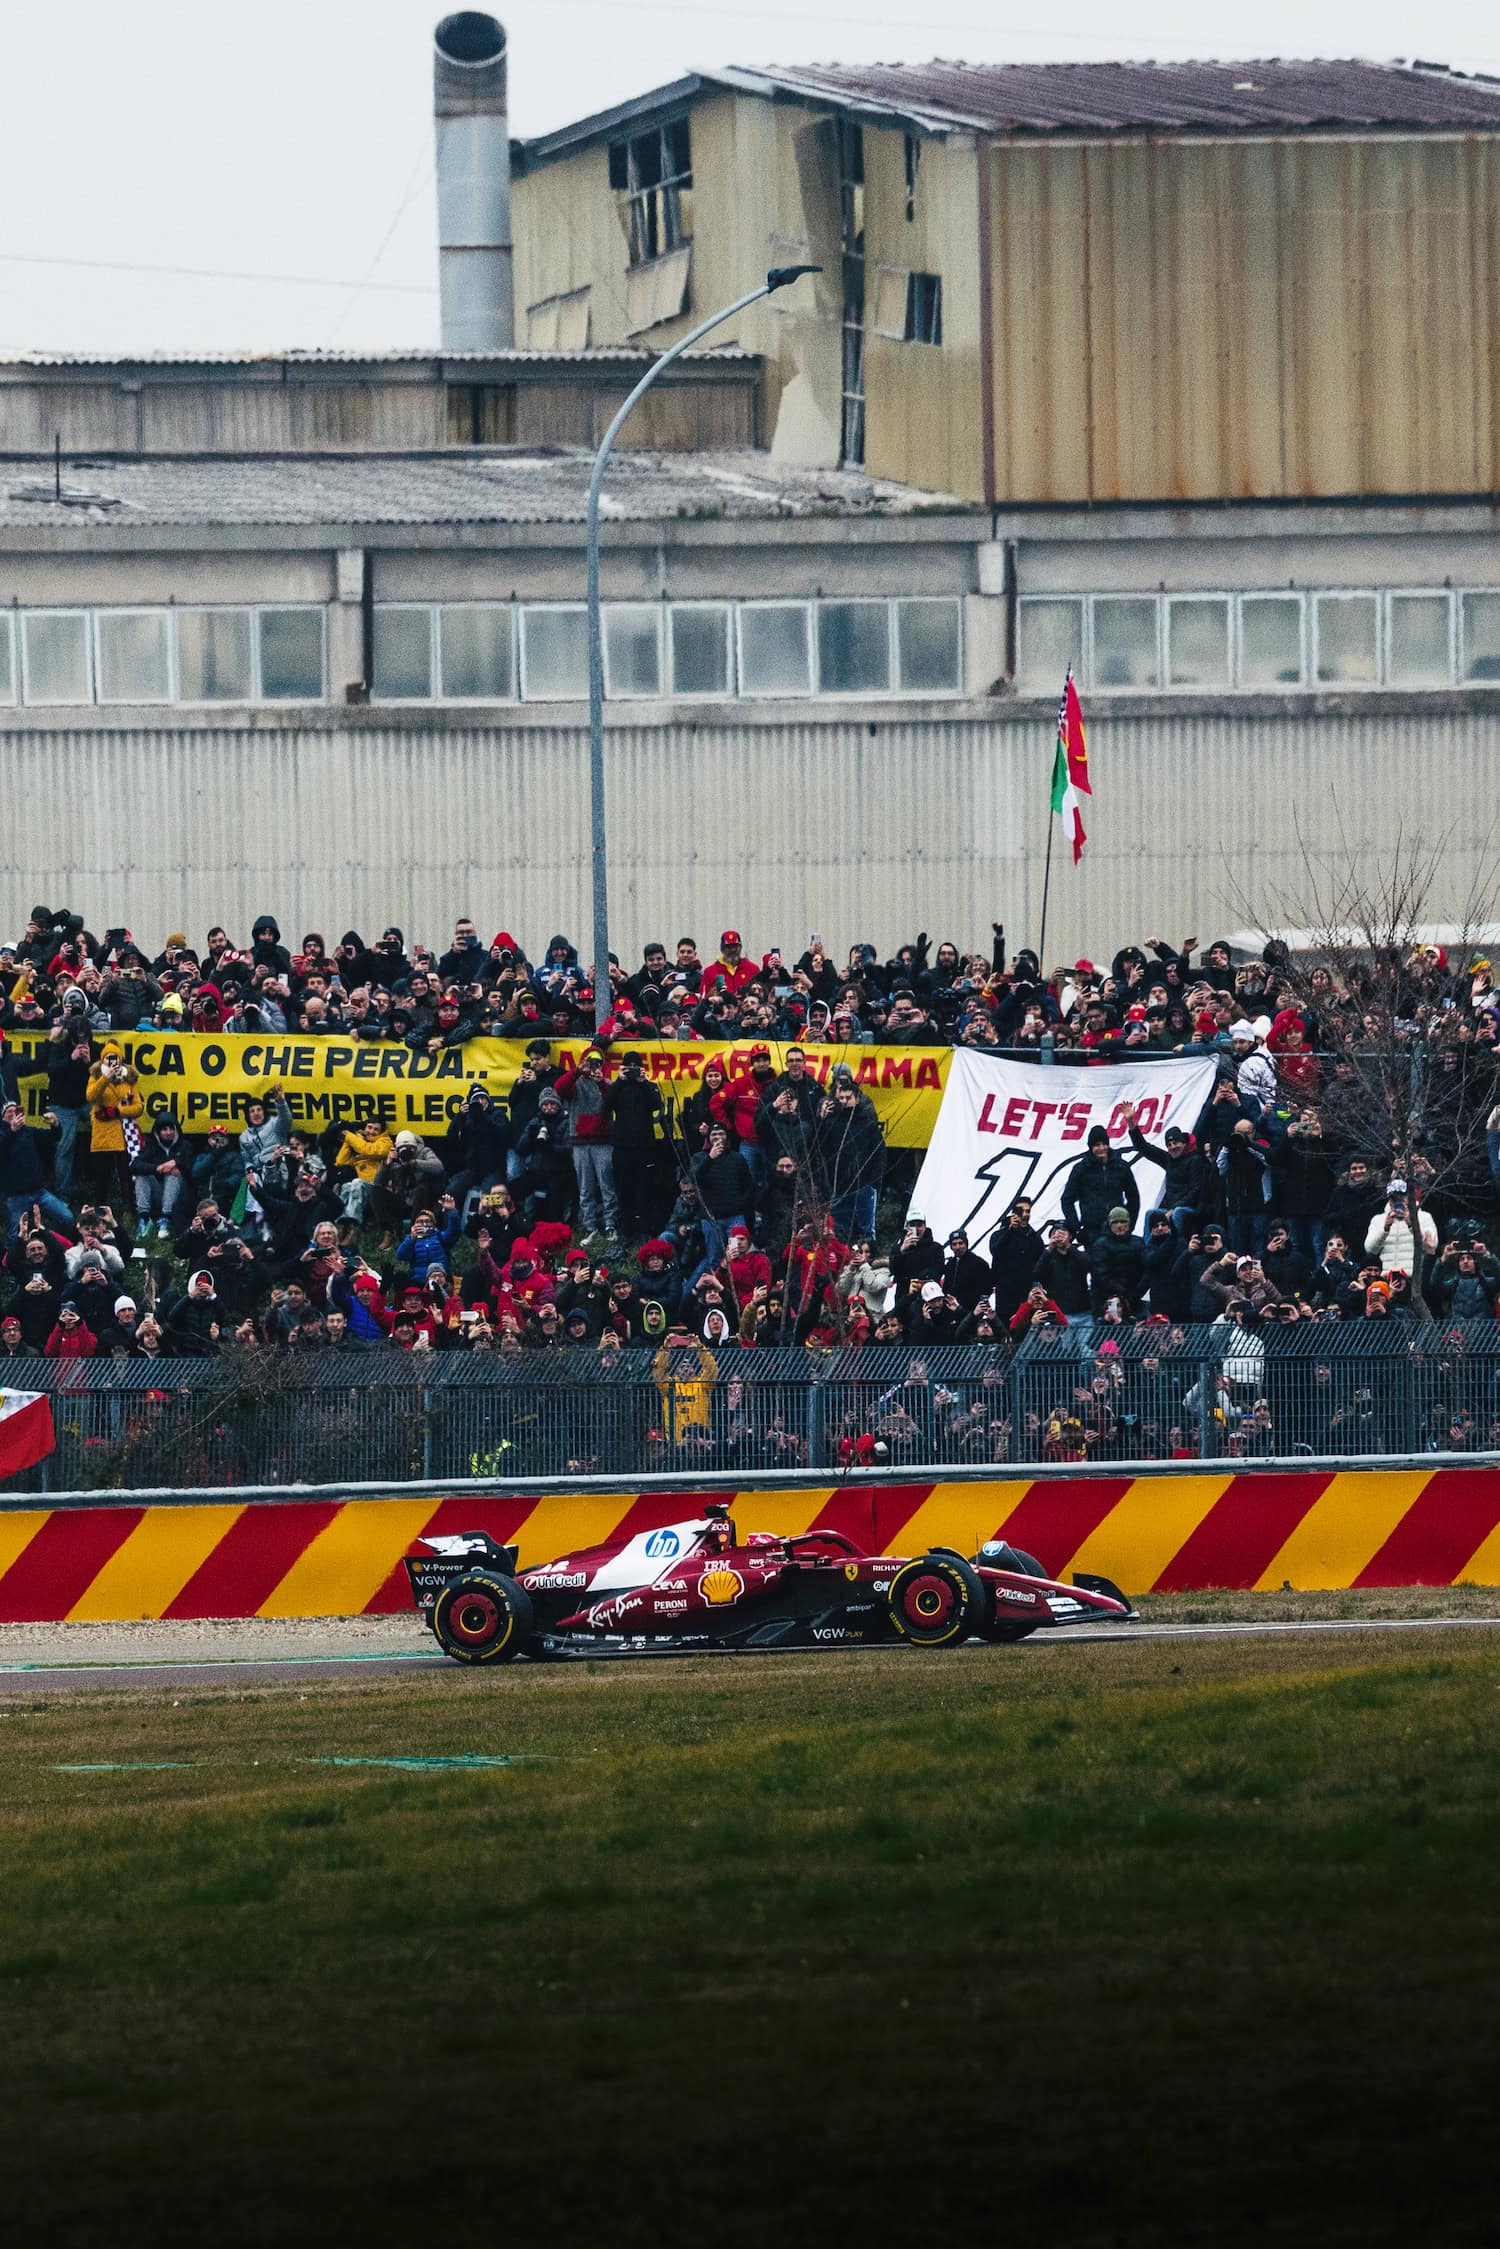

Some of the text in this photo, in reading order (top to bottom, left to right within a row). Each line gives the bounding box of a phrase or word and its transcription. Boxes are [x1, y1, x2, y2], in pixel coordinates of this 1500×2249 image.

[200, 1044, 226, 1077] O
[241, 1045, 315, 1077] CHE
[325, 1047, 488, 1079] PERDA..
[855, 1057, 942, 1090] AMA
[977, 1093, 1092, 1140] LET'S
[648, 1531, 677, 1557] hp
[703, 1559, 731, 1572] IBM
[415, 1575, 446, 1586] VGW
[537, 1572, 587, 1589] UniCredit
[654, 1600, 687, 1610] PERONI
[813, 1628, 845, 1640] VGW
